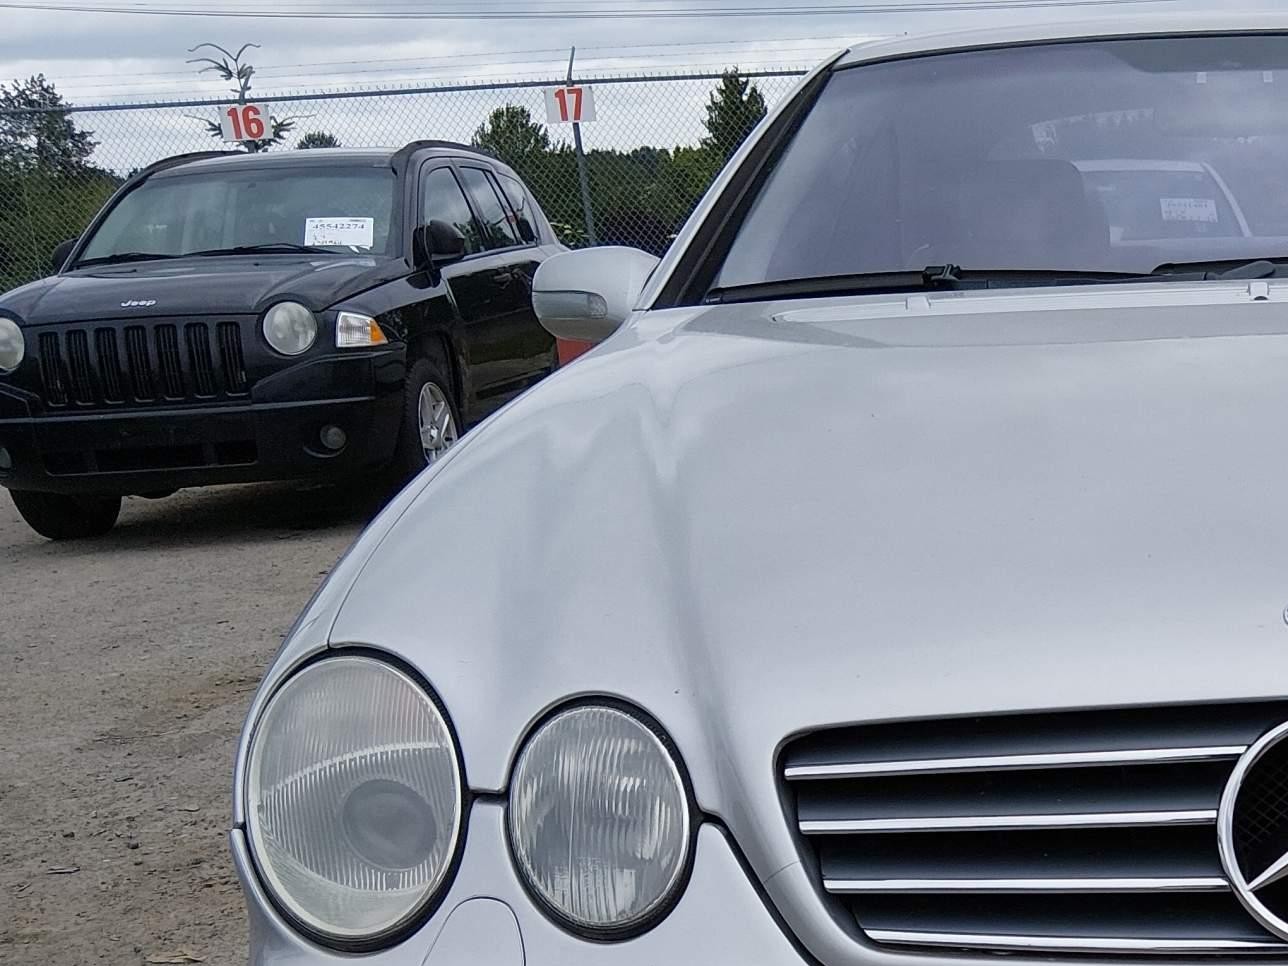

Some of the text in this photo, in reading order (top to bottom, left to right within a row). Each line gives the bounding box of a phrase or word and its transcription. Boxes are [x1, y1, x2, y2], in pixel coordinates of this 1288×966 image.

[554, 87, 583, 122] 17
[226, 105, 265, 140] 16
[120, 299, 157, 307] Jeep
